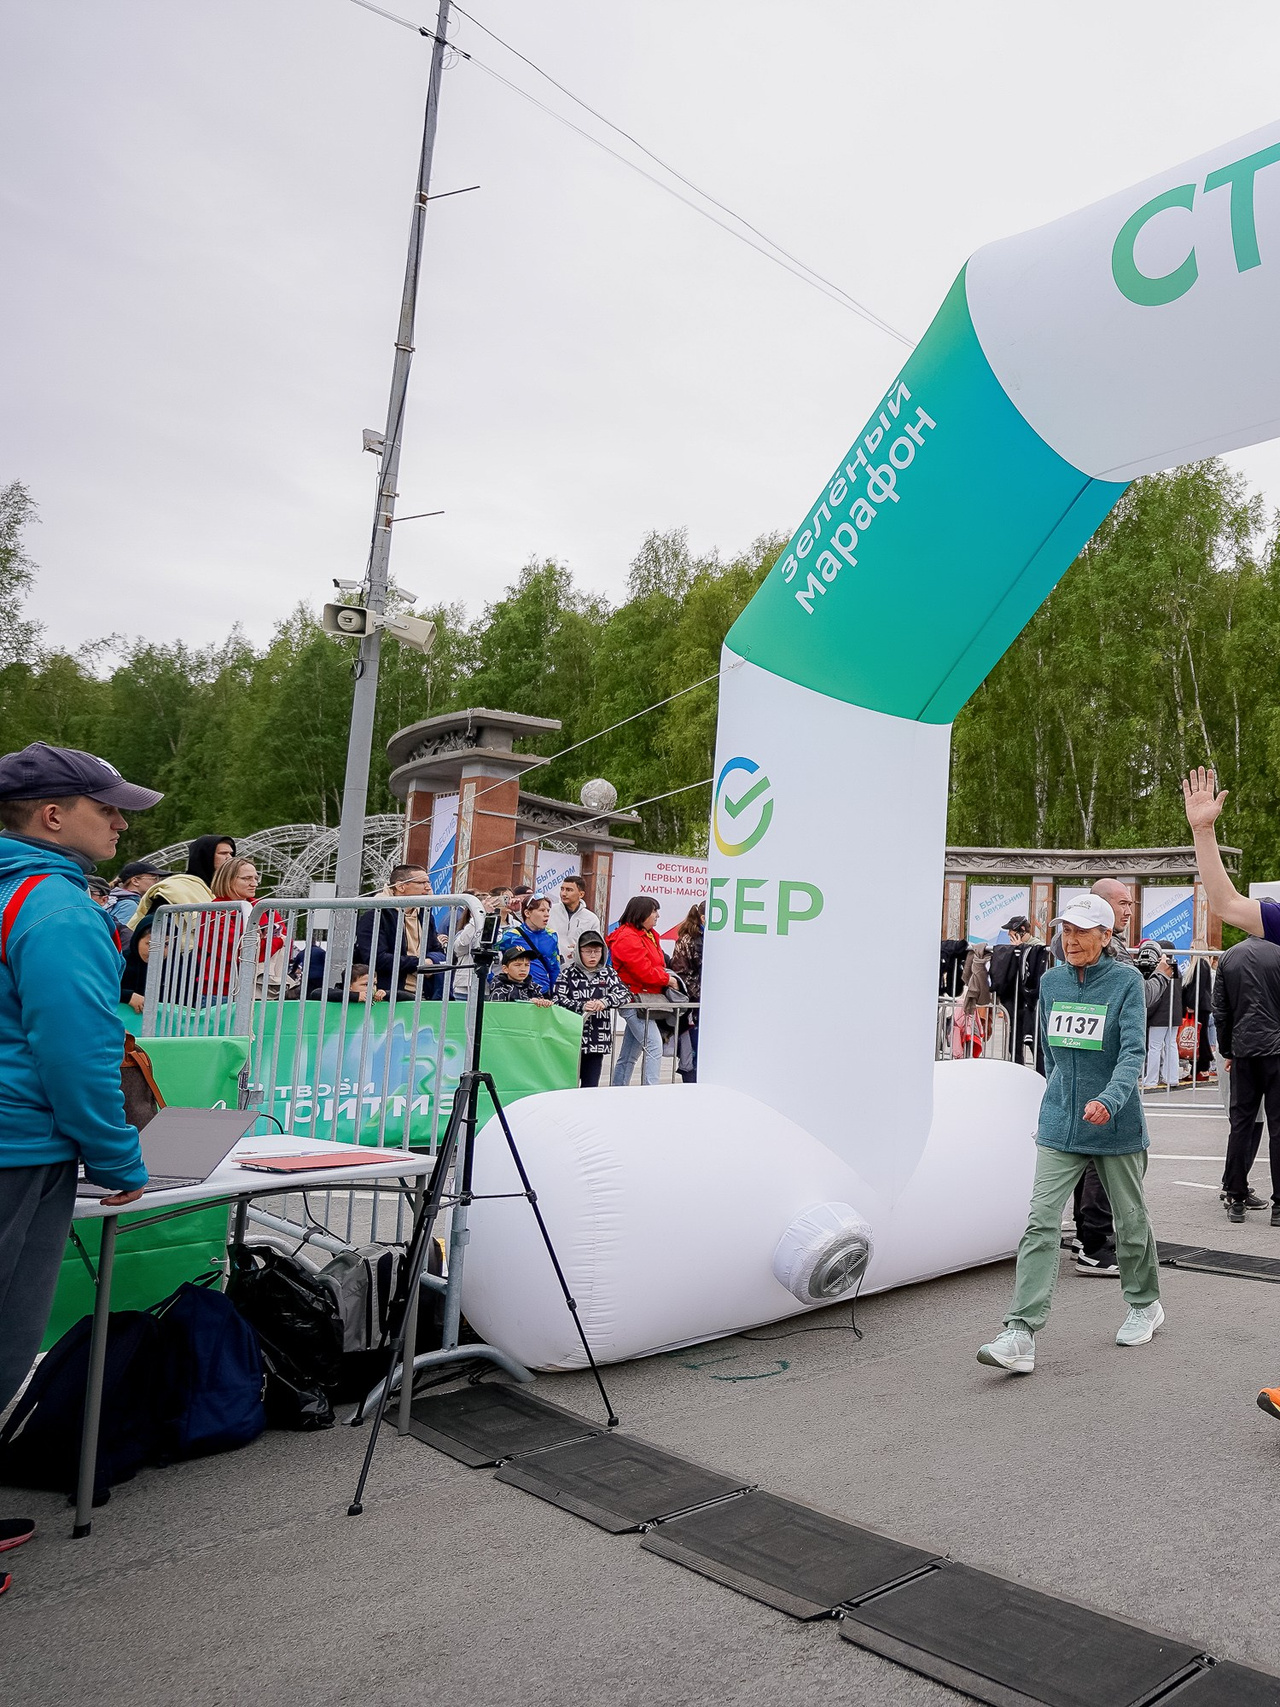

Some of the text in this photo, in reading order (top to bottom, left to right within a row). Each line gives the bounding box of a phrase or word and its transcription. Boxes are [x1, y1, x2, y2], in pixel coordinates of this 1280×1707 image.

[781, 379, 912, 584] зелёный
[794, 406, 937, 615] марафон
[536, 868, 557, 885] БЫТЬ
[536, 865, 576, 894] ЕЛОВЕКОМ
[644, 872, 684, 884] ПЕРВЫХ
[686, 876, 693, 885] В
[656, 862, 708, 875] ФЕСТИВАЛ
[979, 893, 1005, 910] БЫТЬ
[1148, 909, 1191, 940] ДВИЖЕНИЕ
[1055, 1014, 1099, 1036] 1137
